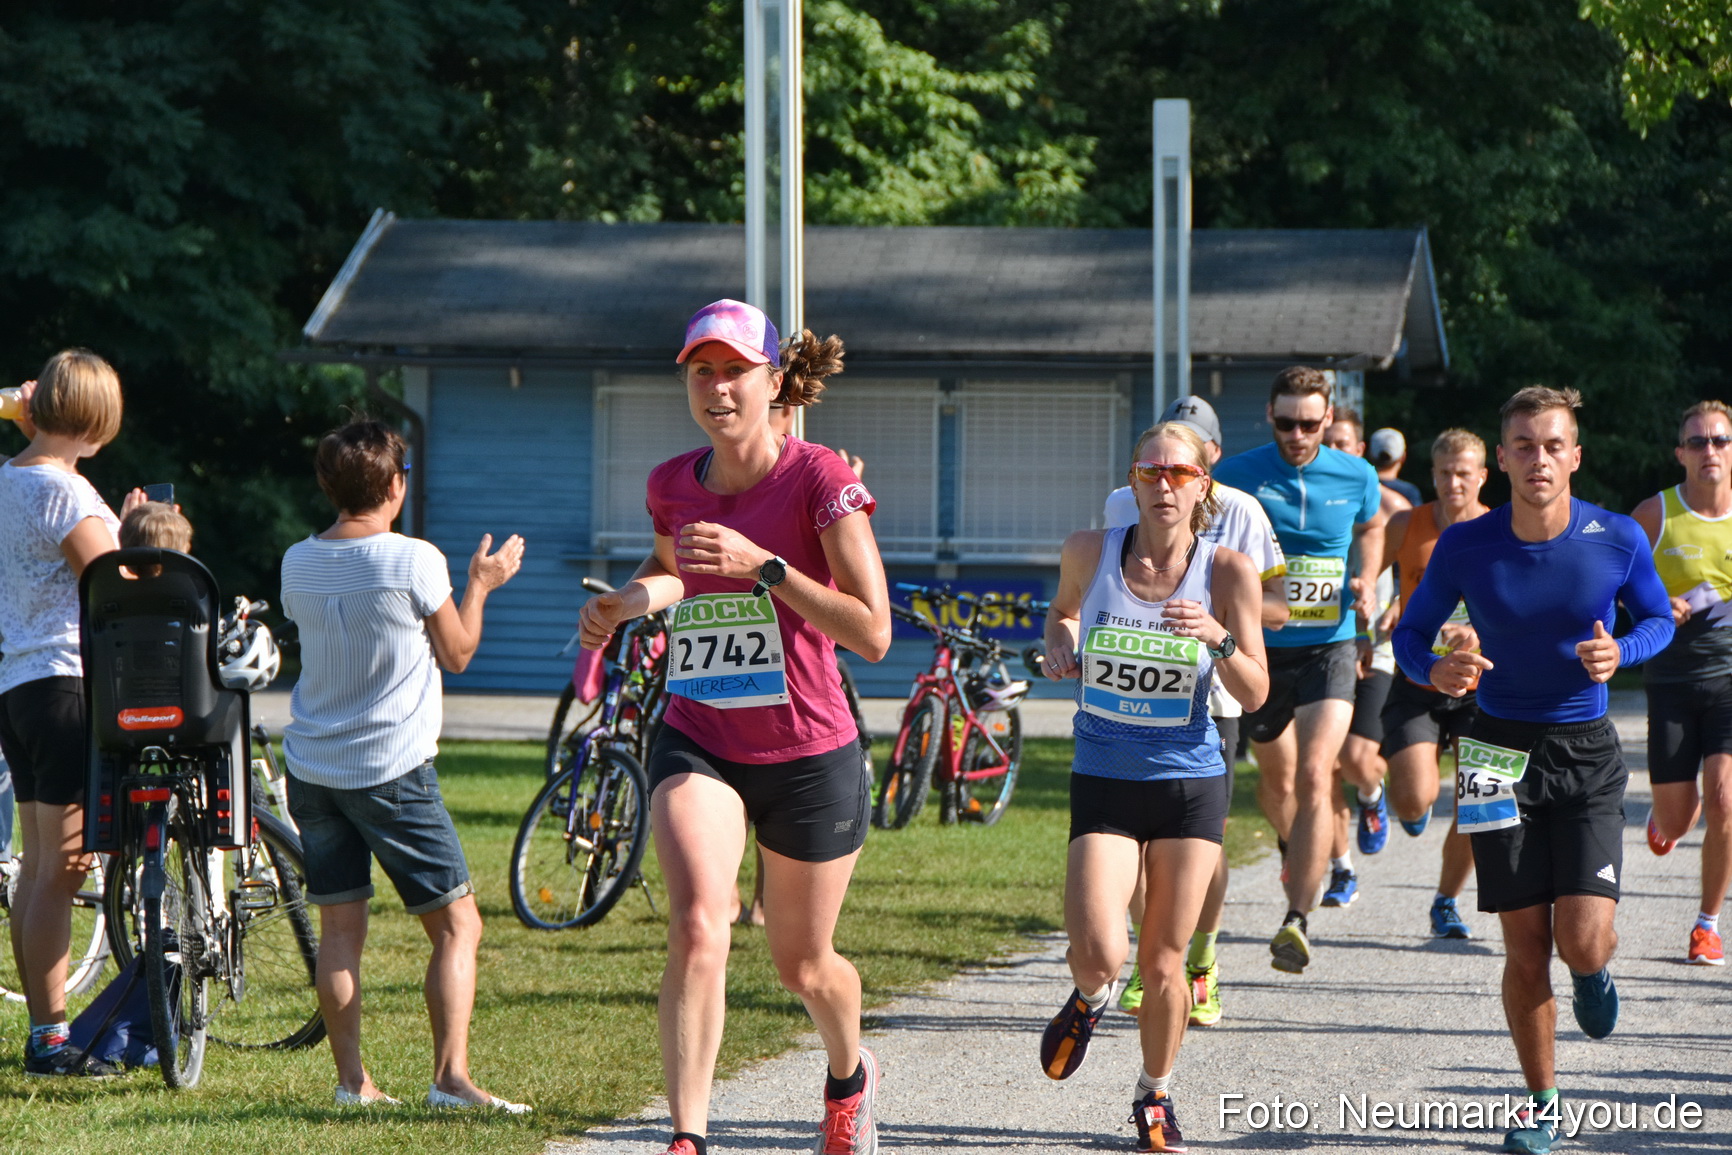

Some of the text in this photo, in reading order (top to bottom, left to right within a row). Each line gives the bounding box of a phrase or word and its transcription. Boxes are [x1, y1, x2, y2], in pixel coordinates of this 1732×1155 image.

[1285, 561, 1338, 574] OCK
[1282, 581, 1333, 602] 320
[679, 598, 763, 625] BOCK
[912, 591, 1033, 629] KIOSK
[1111, 616, 1143, 628] TELIS
[678, 631, 769, 672] 2742
[1095, 631, 1188, 661] BOCK
[680, 675, 761, 697] THERESA
[1096, 660, 1182, 693] 2502
[124, 714, 175, 723] Polisport
[1118, 700, 1152, 715] EVA
[1459, 743, 1516, 772] OCK
